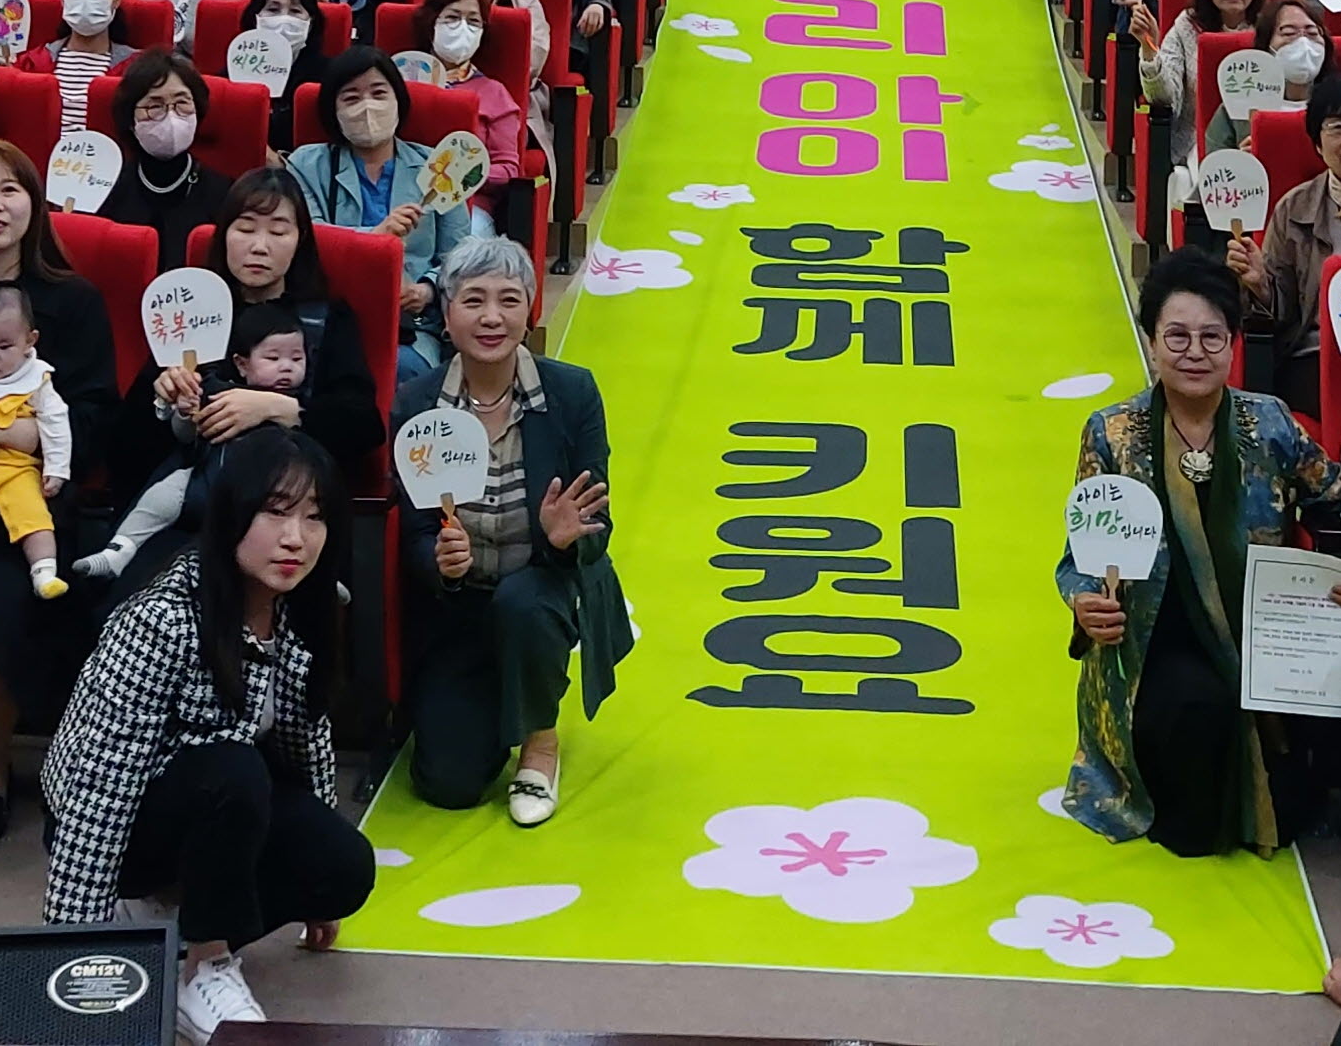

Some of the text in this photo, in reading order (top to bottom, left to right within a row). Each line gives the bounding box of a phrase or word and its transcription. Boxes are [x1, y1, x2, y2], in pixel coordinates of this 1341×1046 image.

[237, 41, 269, 52] 아이는
[1227, 60, 1261, 74] 아이는
[756, 71, 964, 182] 아이
[61, 141, 95, 156] 아이는
[1203, 168, 1236, 188] 아이는
[1205, 186, 1264, 211] 사랑입니다
[150, 285, 194, 311] 아이는
[731, 222, 970, 367] 함께
[151, 311, 223, 344] 축복입니다
[407, 420, 453, 439] 아이는
[1077, 482, 1123, 504] 아이는
[1069, 506, 1157, 539] 희망입니다
[684, 421, 976, 716] 키워요
[70, 963, 126, 977] CM12V
